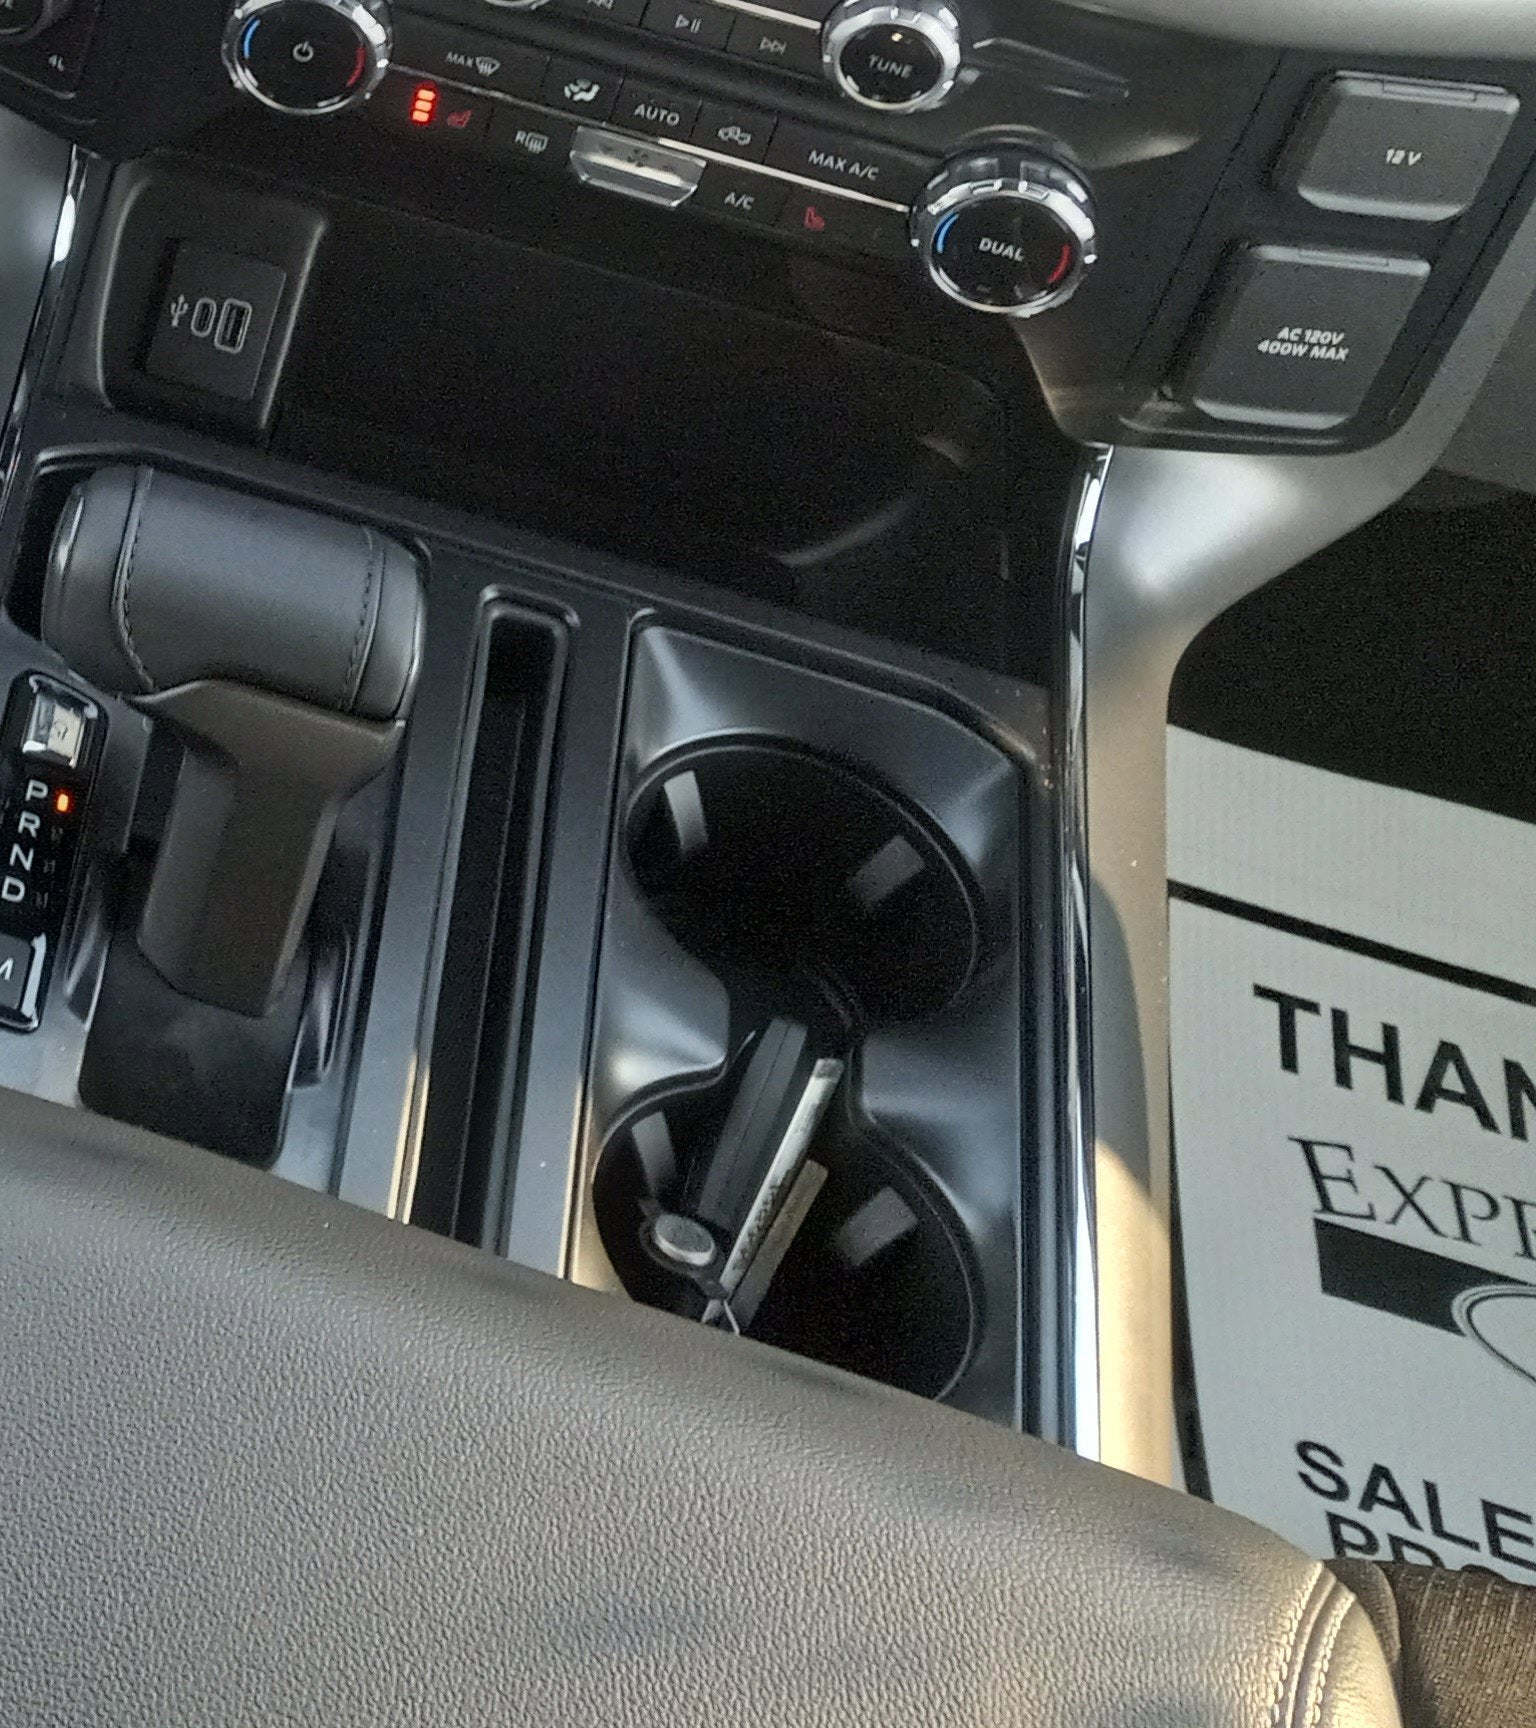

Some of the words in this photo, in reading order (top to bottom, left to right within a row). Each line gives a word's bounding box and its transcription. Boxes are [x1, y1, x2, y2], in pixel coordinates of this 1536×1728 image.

[446, 51, 475, 68] MAX
[868, 55, 914, 79] TUNE
[634, 103, 680, 126] AUTO
[809, 150, 848, 173] MAX
[849, 160, 879, 181] A/C
[724, 192, 755, 210] A/C
[979, 237, 1024, 262] DUAL
[1277, 326, 1303, 341] AC
[1304, 329, 1345, 345] 120V
[1257, 339, 1308, 357] 400W
[1309, 345, 1349, 361] MAX
[25, 779, 48, 802] P
[18, 810, 41, 839] R
[9, 843, 34, 871] N
[1, 876, 25, 903] D
